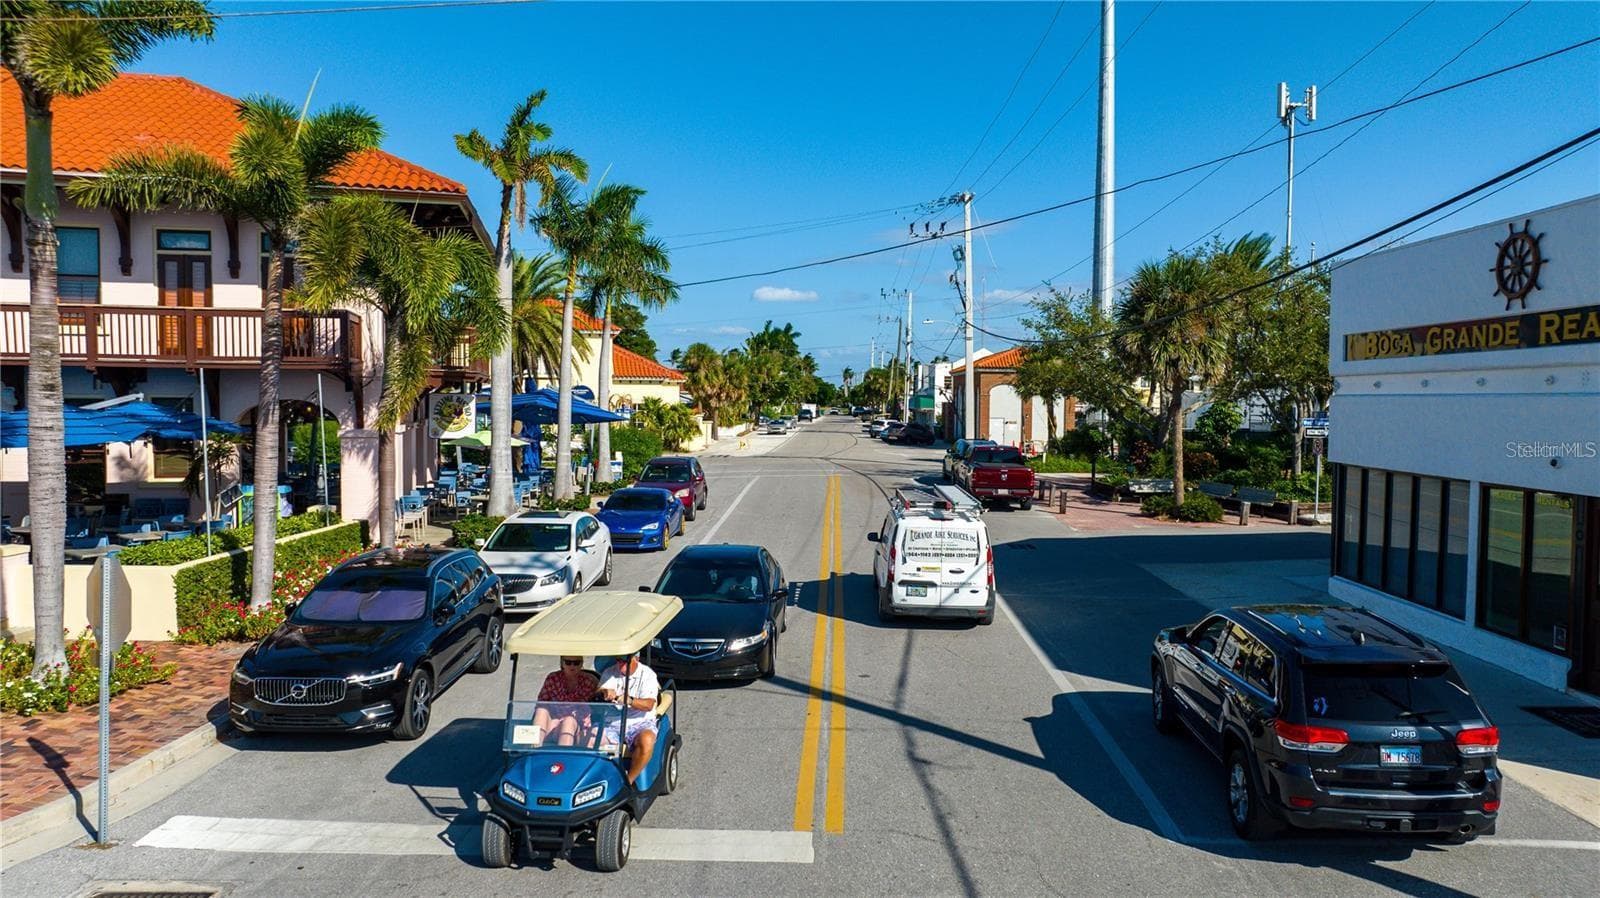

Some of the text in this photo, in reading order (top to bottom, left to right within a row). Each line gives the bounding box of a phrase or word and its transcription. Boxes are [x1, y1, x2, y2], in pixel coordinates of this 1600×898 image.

[1366, 311, 1600, 357] BOCA GRANDE REA
[1391, 728, 1417, 739] Jeep
